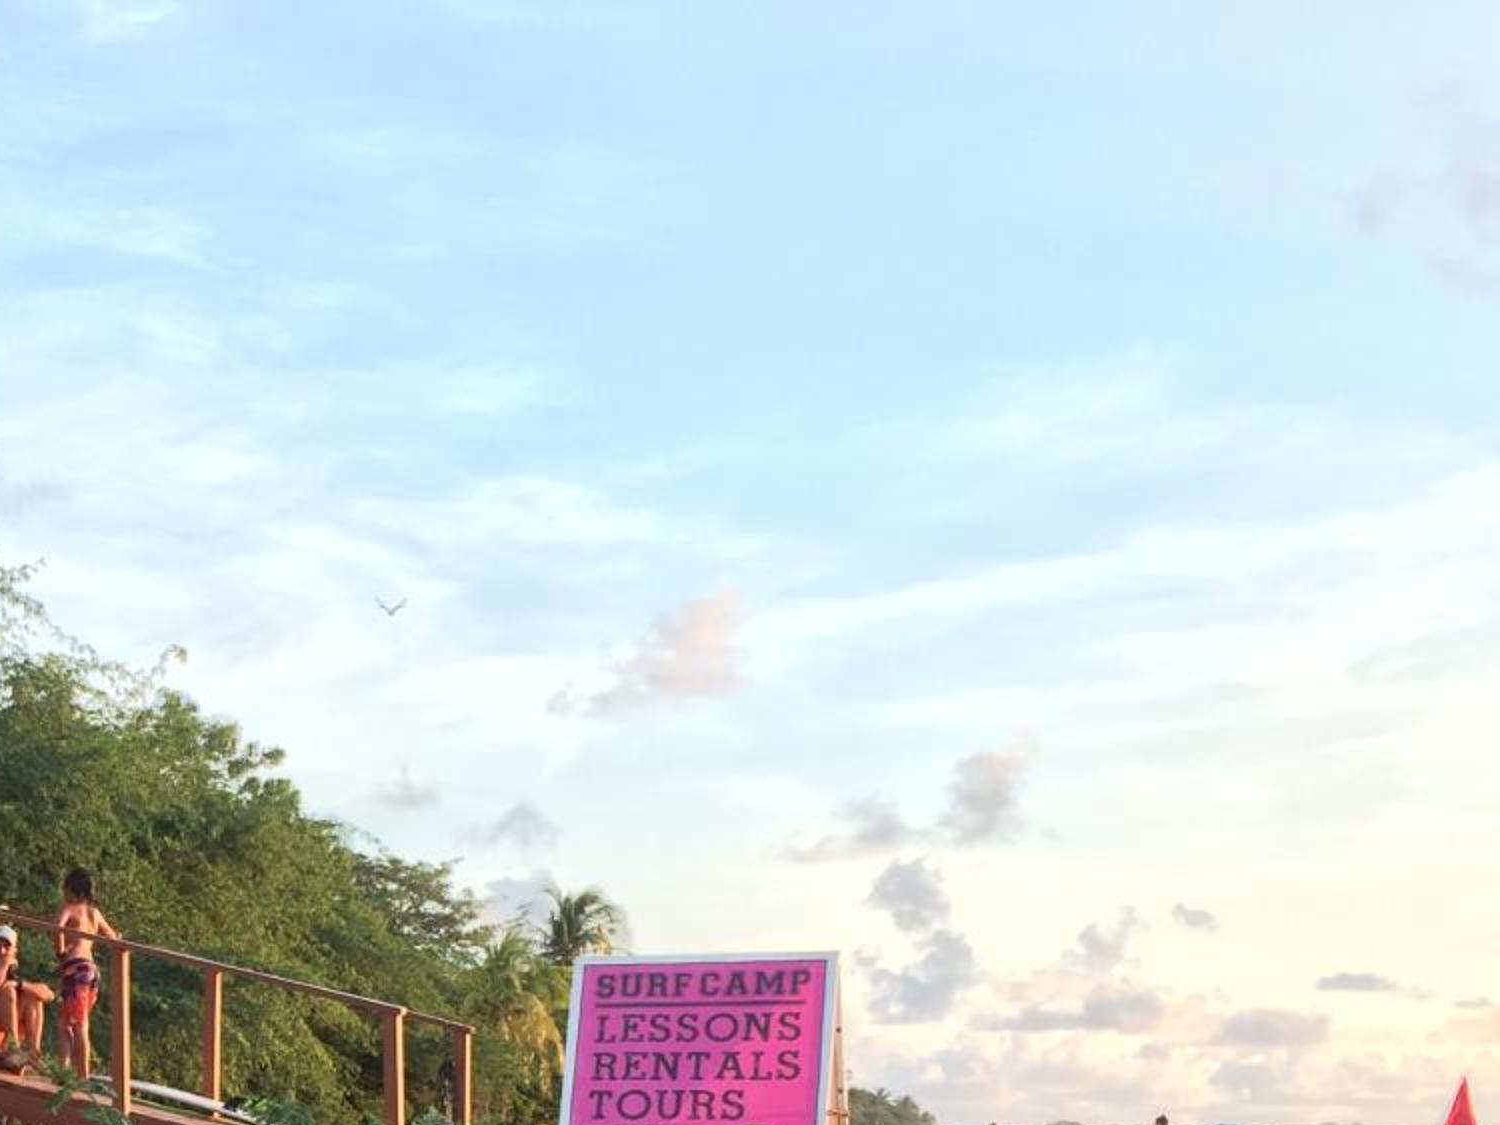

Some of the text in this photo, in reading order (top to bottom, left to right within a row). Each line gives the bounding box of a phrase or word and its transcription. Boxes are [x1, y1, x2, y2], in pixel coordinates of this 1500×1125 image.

[596, 969, 811, 998] SURF CAMP
[595, 1012, 803, 1044] LESSONS
[591, 1050, 801, 1082] RENTALS
[589, 1089, 746, 1121] TOURS
